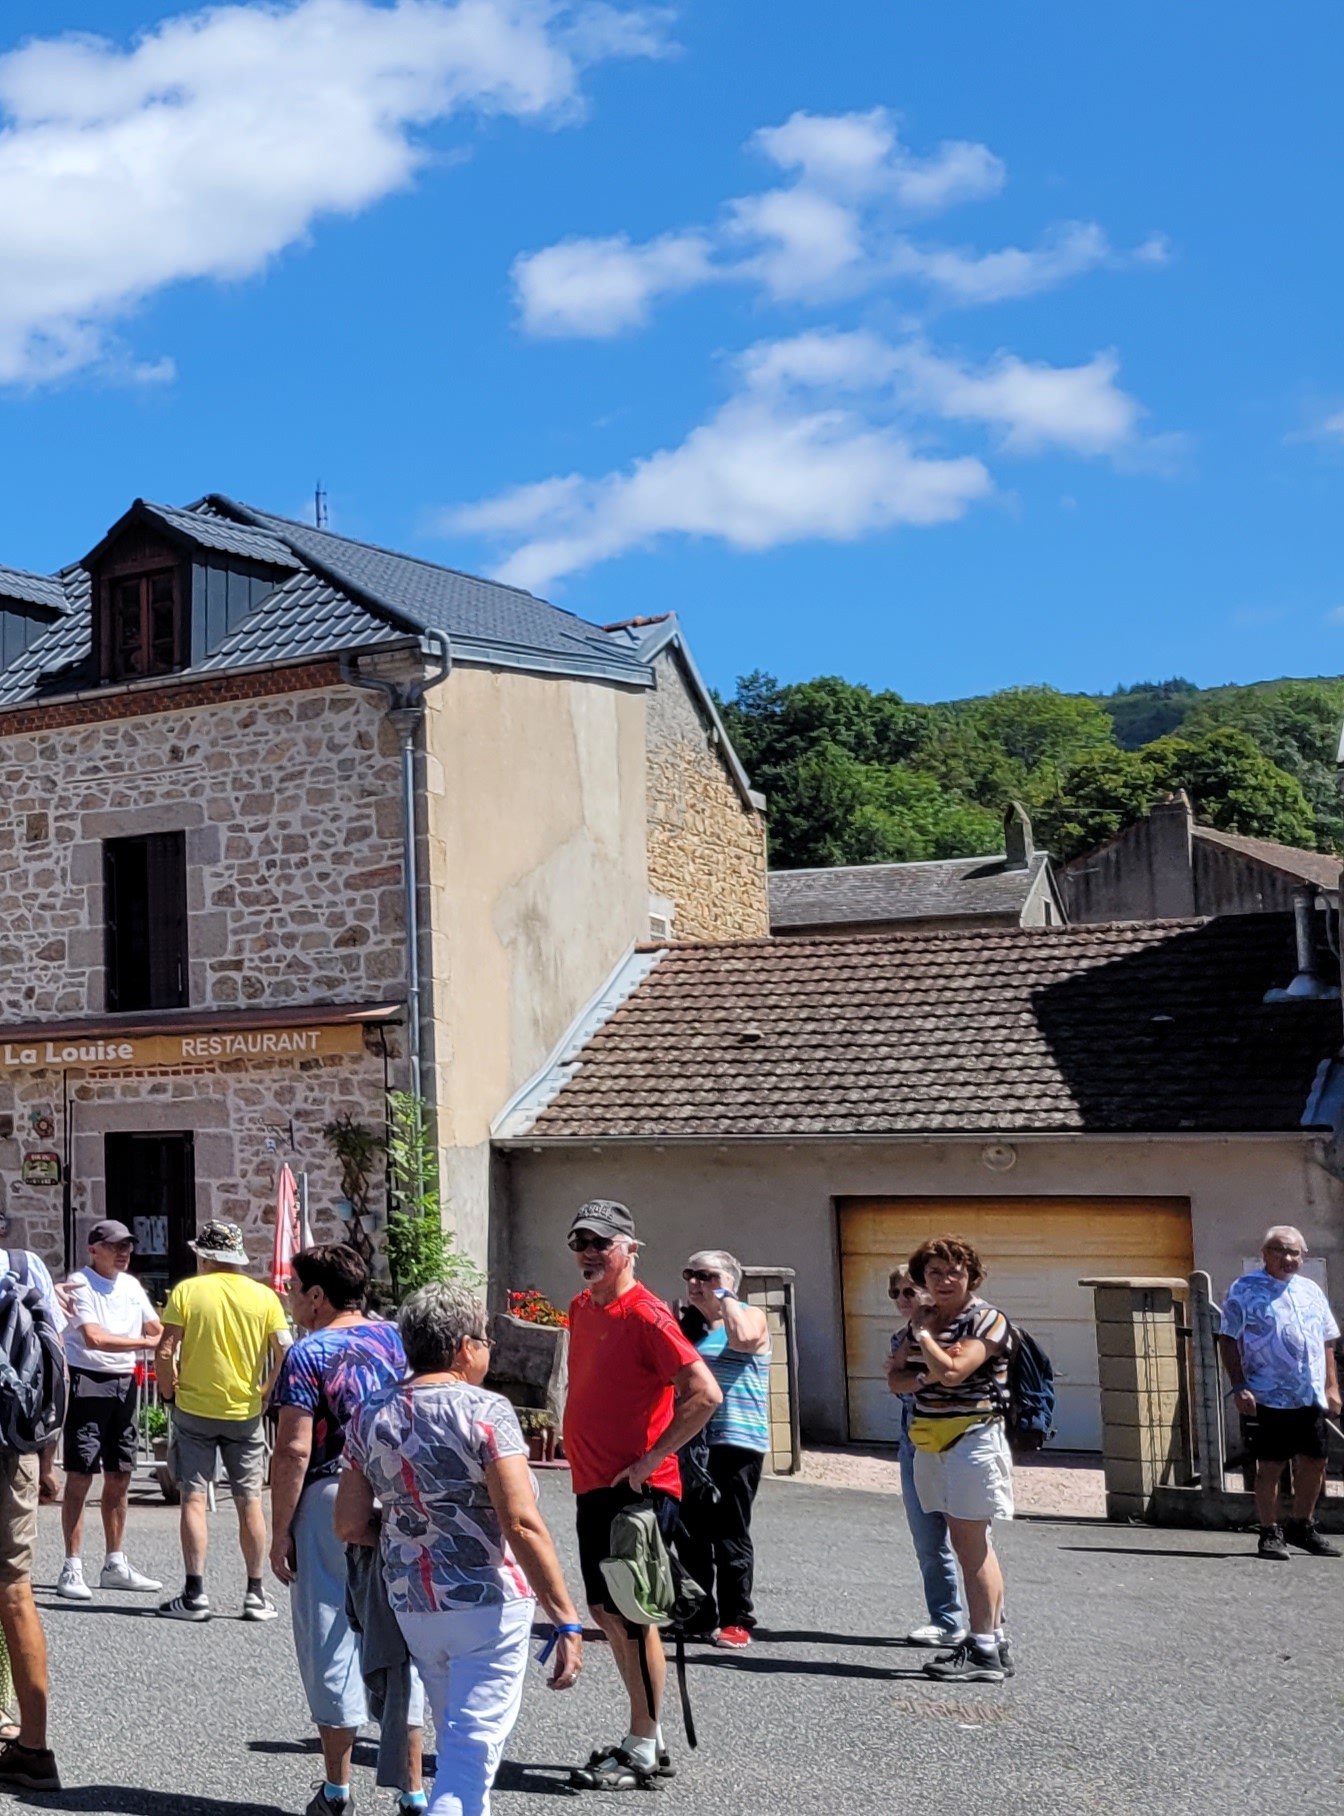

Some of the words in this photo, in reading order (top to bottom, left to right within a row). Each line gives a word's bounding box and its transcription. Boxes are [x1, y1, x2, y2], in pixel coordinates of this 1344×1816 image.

[4, 1044, 37, 1065] La
[45, 1040, 134, 1063] Louise
[181, 1031, 321, 1057] RESTAURANT
